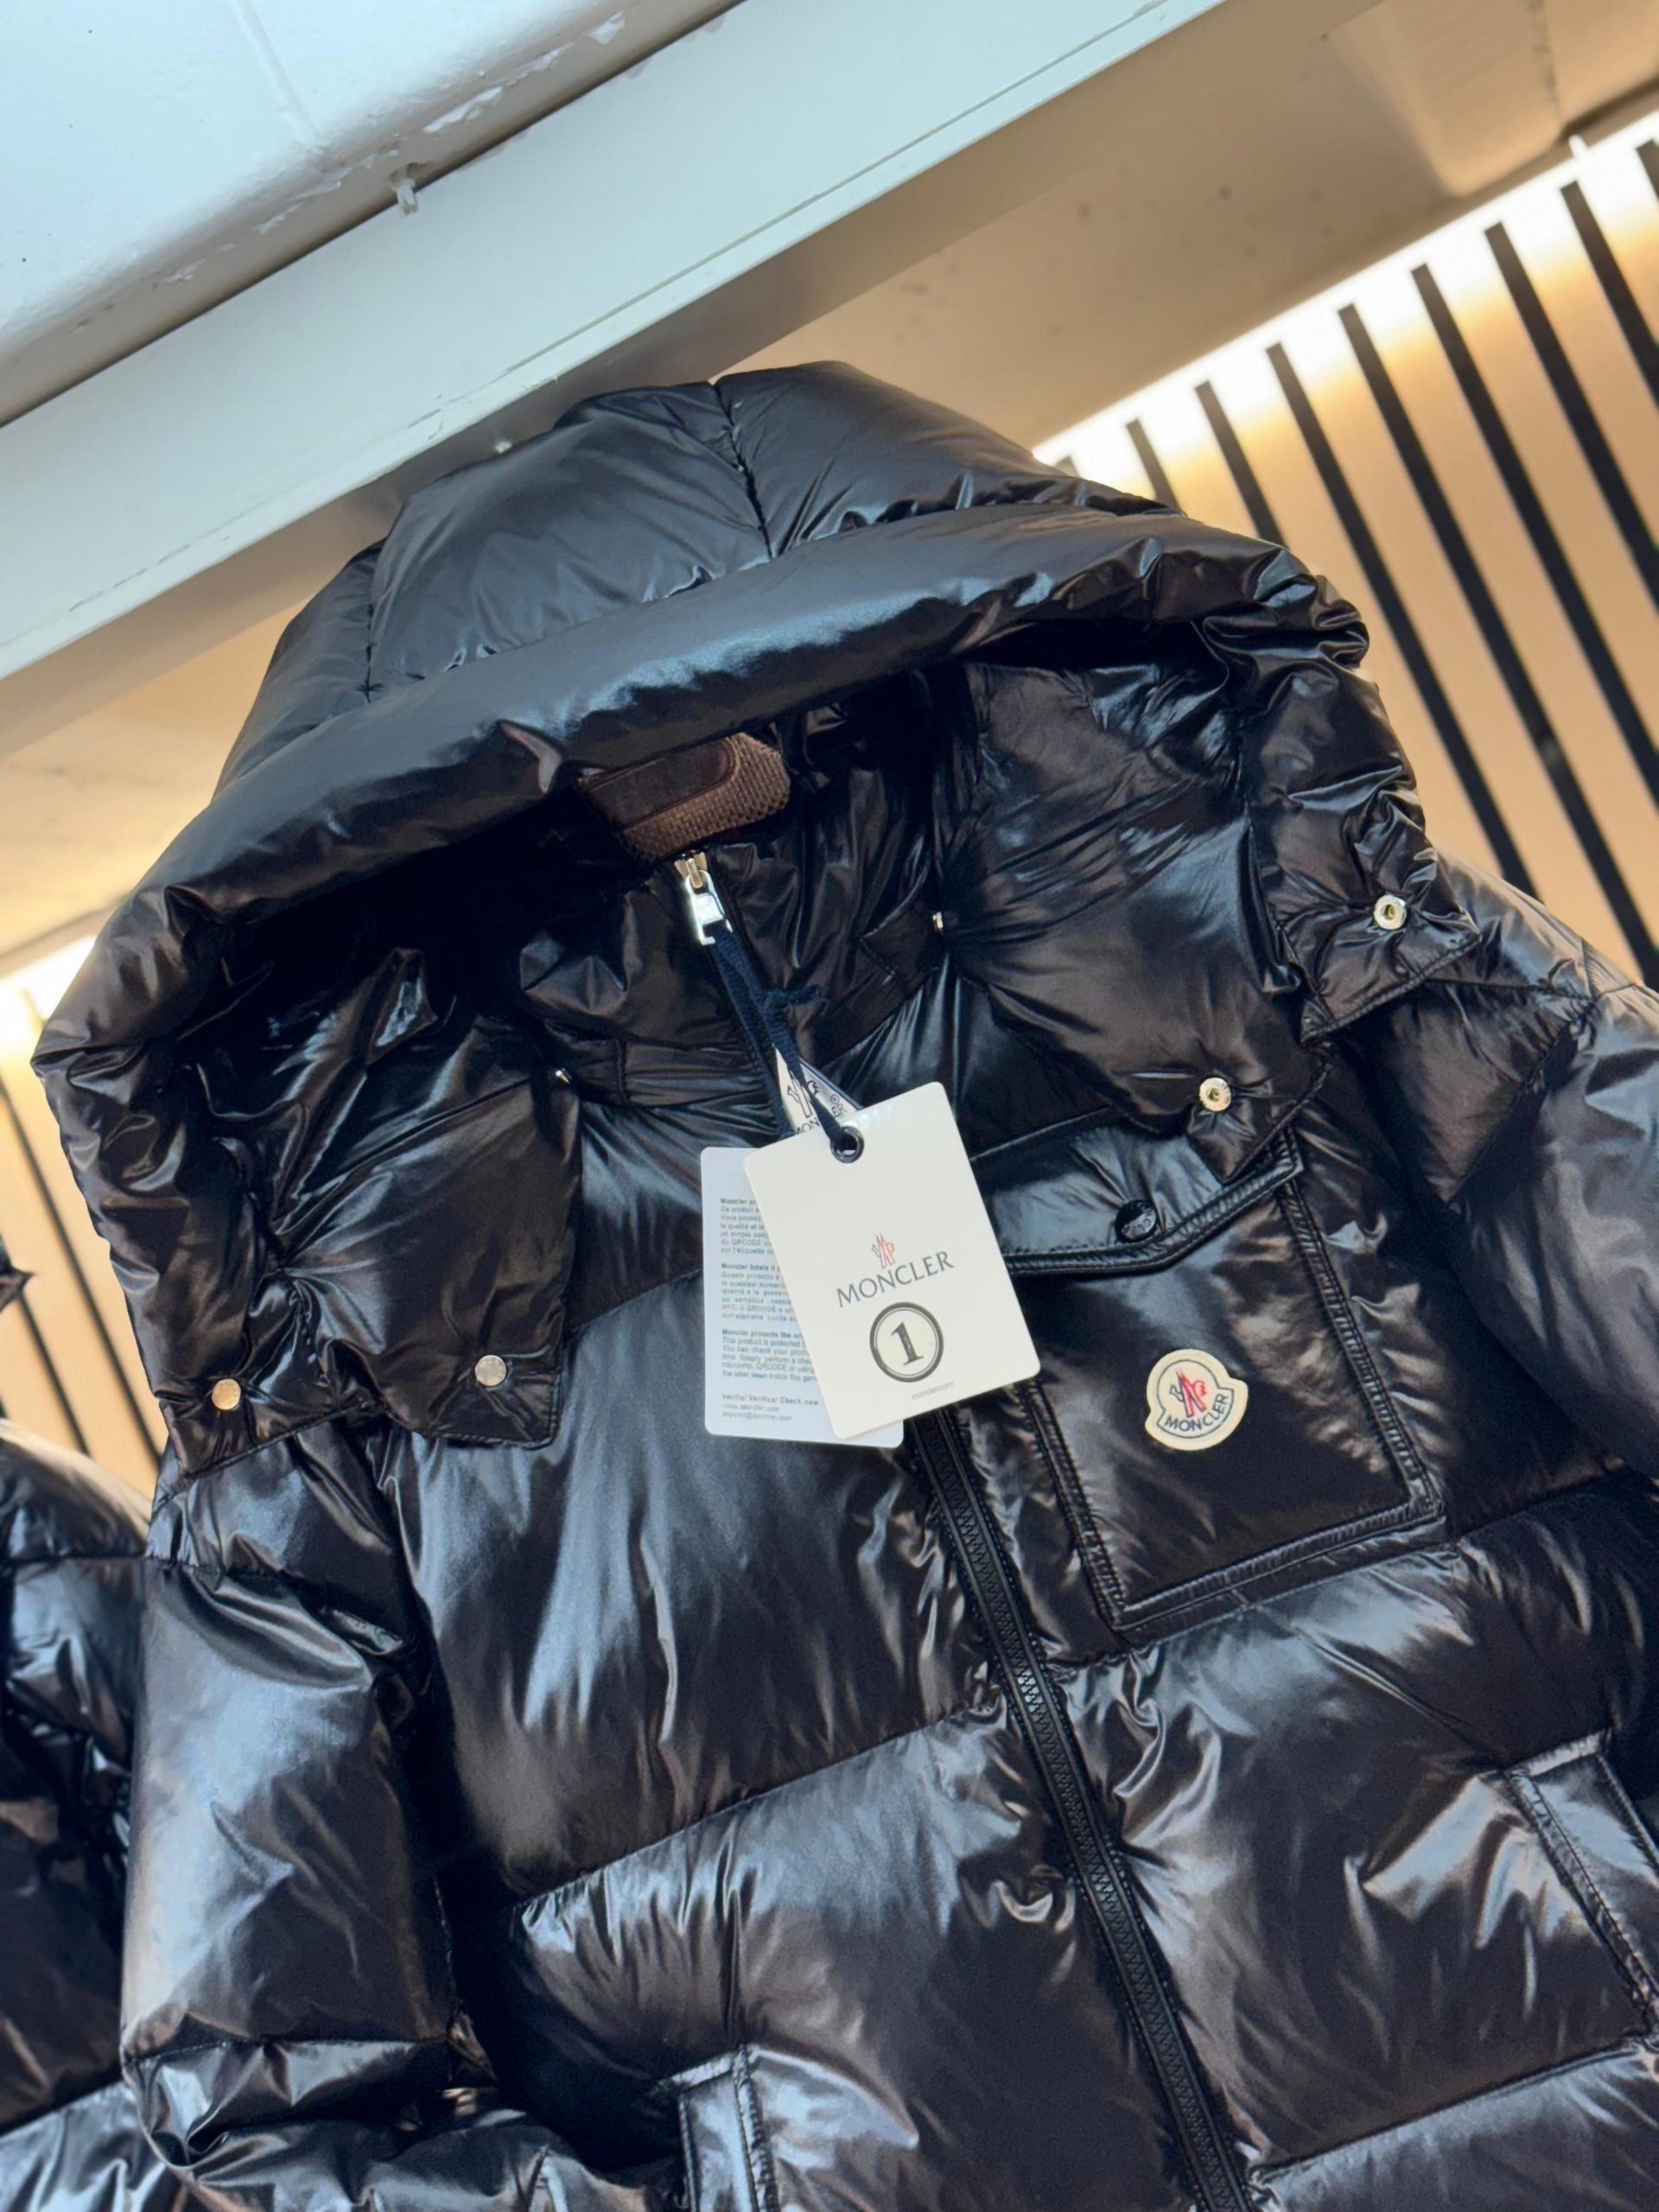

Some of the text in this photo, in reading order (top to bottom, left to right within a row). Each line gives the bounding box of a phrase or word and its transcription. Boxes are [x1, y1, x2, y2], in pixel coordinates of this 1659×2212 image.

[836, 1250, 956, 1308] MONCLER
[890, 1321, 925, 1366] 1
[779, 1396, 801, 1405] Check
[911, 1381, 955, 1401] moncler.com
[1164, 1392, 1230, 1432] MONCLER
